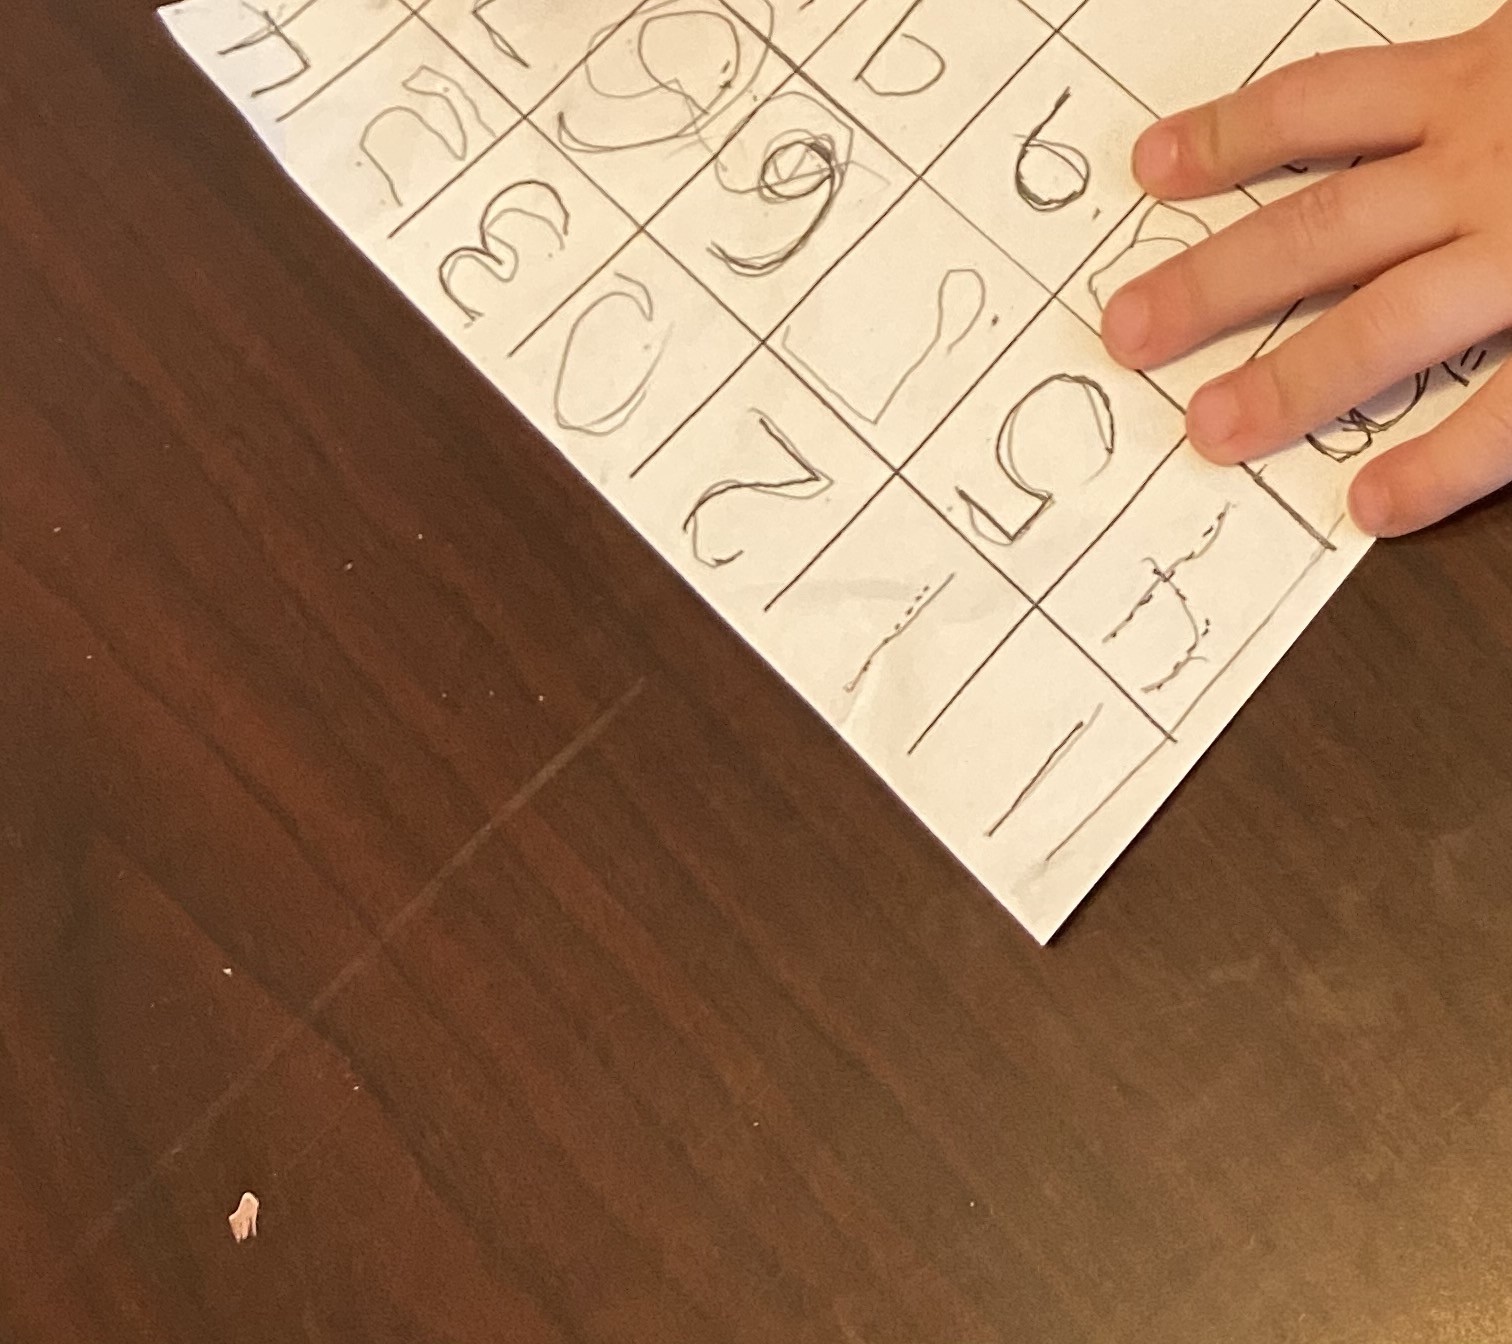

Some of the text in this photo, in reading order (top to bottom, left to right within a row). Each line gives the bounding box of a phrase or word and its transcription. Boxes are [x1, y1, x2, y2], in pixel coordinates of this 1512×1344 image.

[438, 178, 571, 330] 3
[681, 407, 835, 569] 2
[954, 371, 1117, 548] 5
